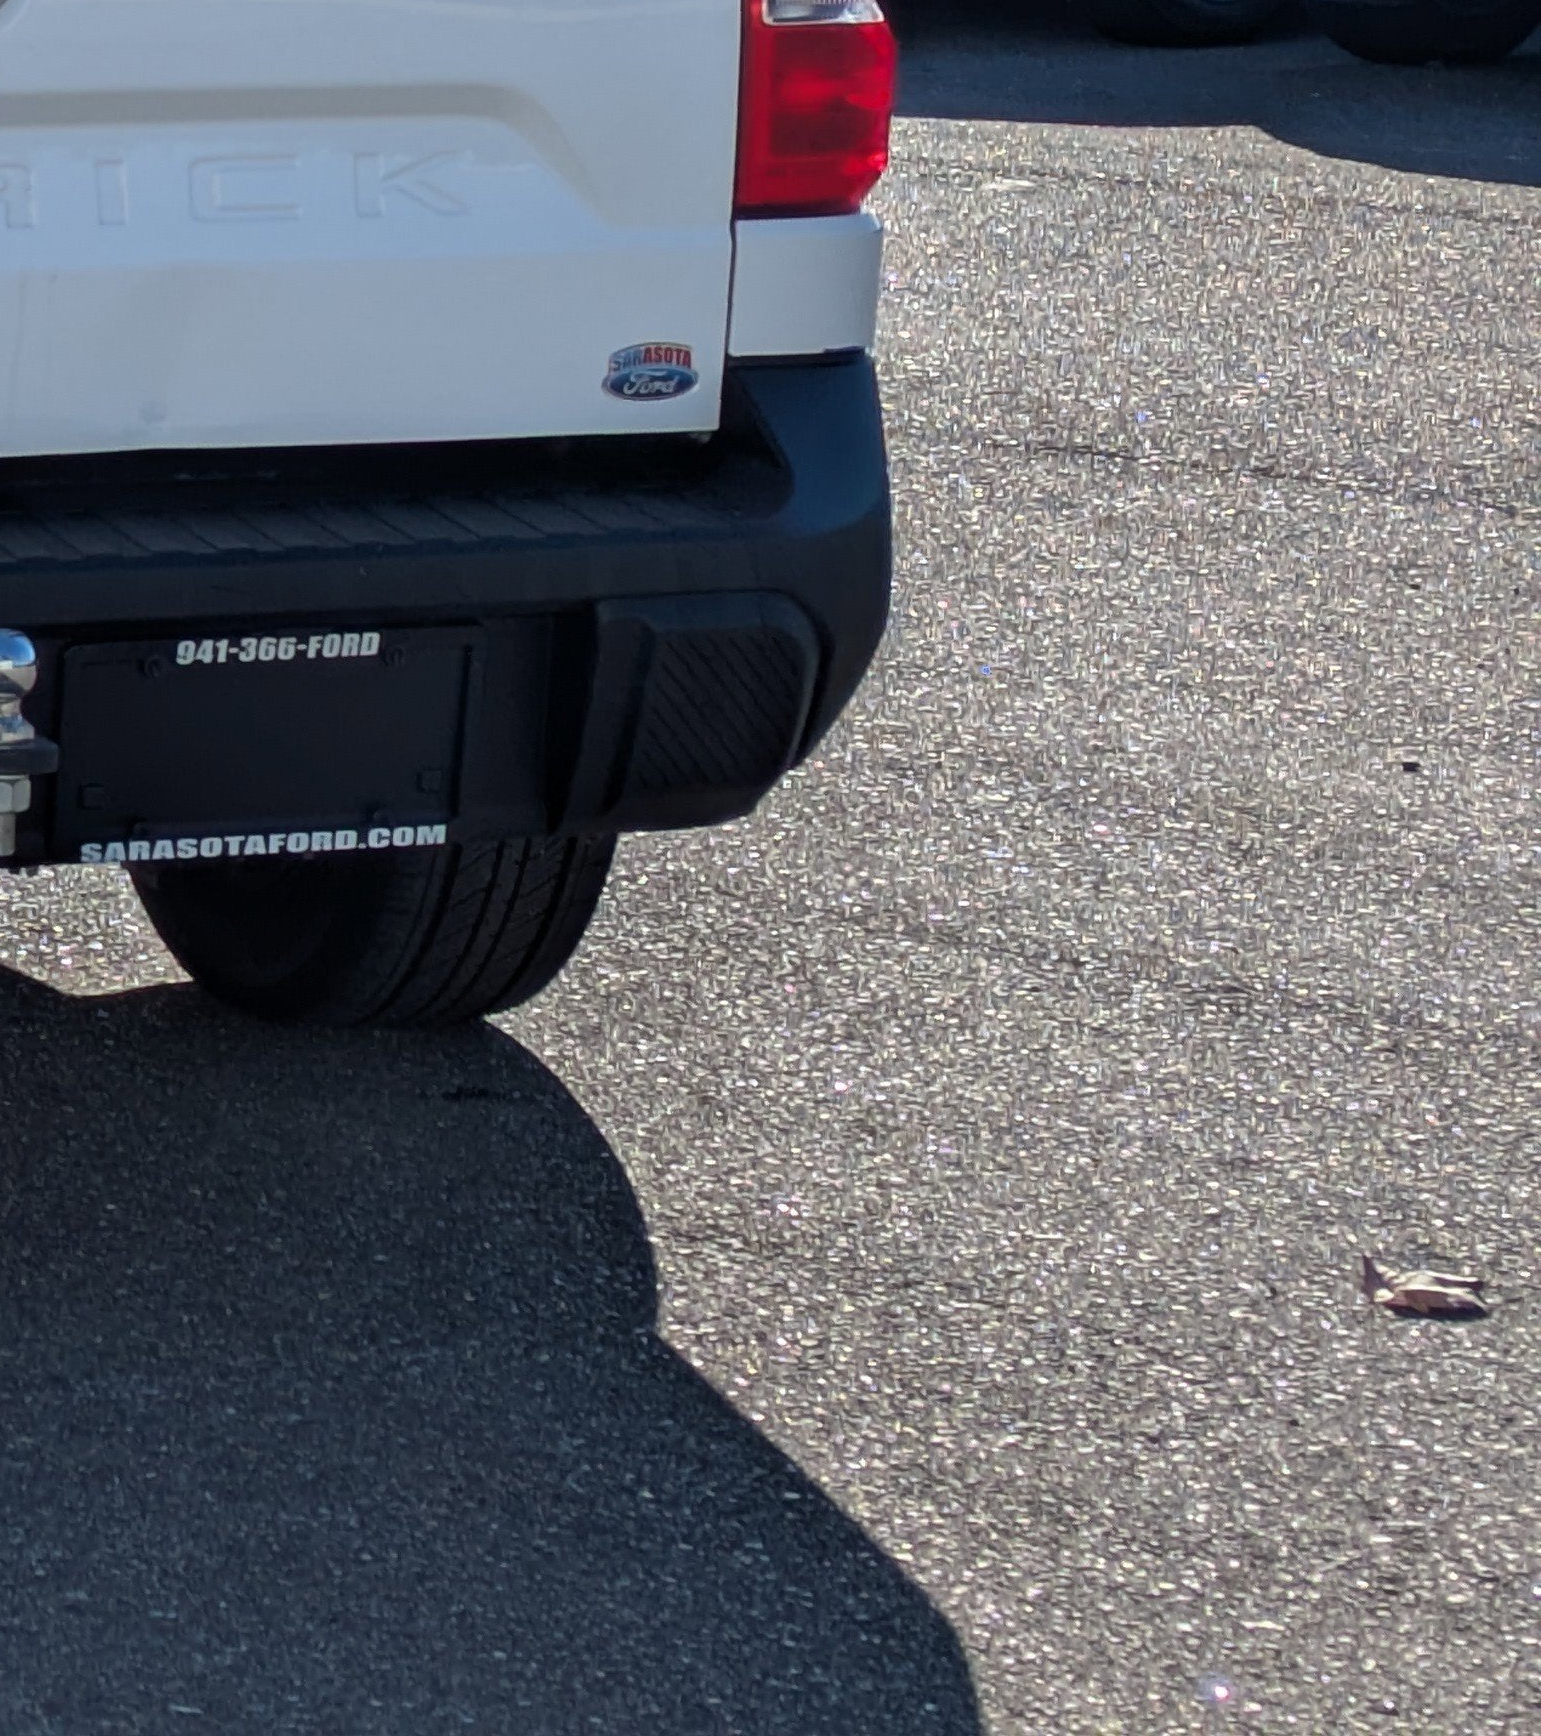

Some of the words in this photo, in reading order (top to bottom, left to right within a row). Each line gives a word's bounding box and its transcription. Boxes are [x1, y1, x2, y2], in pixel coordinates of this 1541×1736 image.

[623, 369, 678, 395] Ford
[176, 632, 380, 665] 941-366-FORD
[80, 824, 447, 864] SARASOTAFORD.COM
